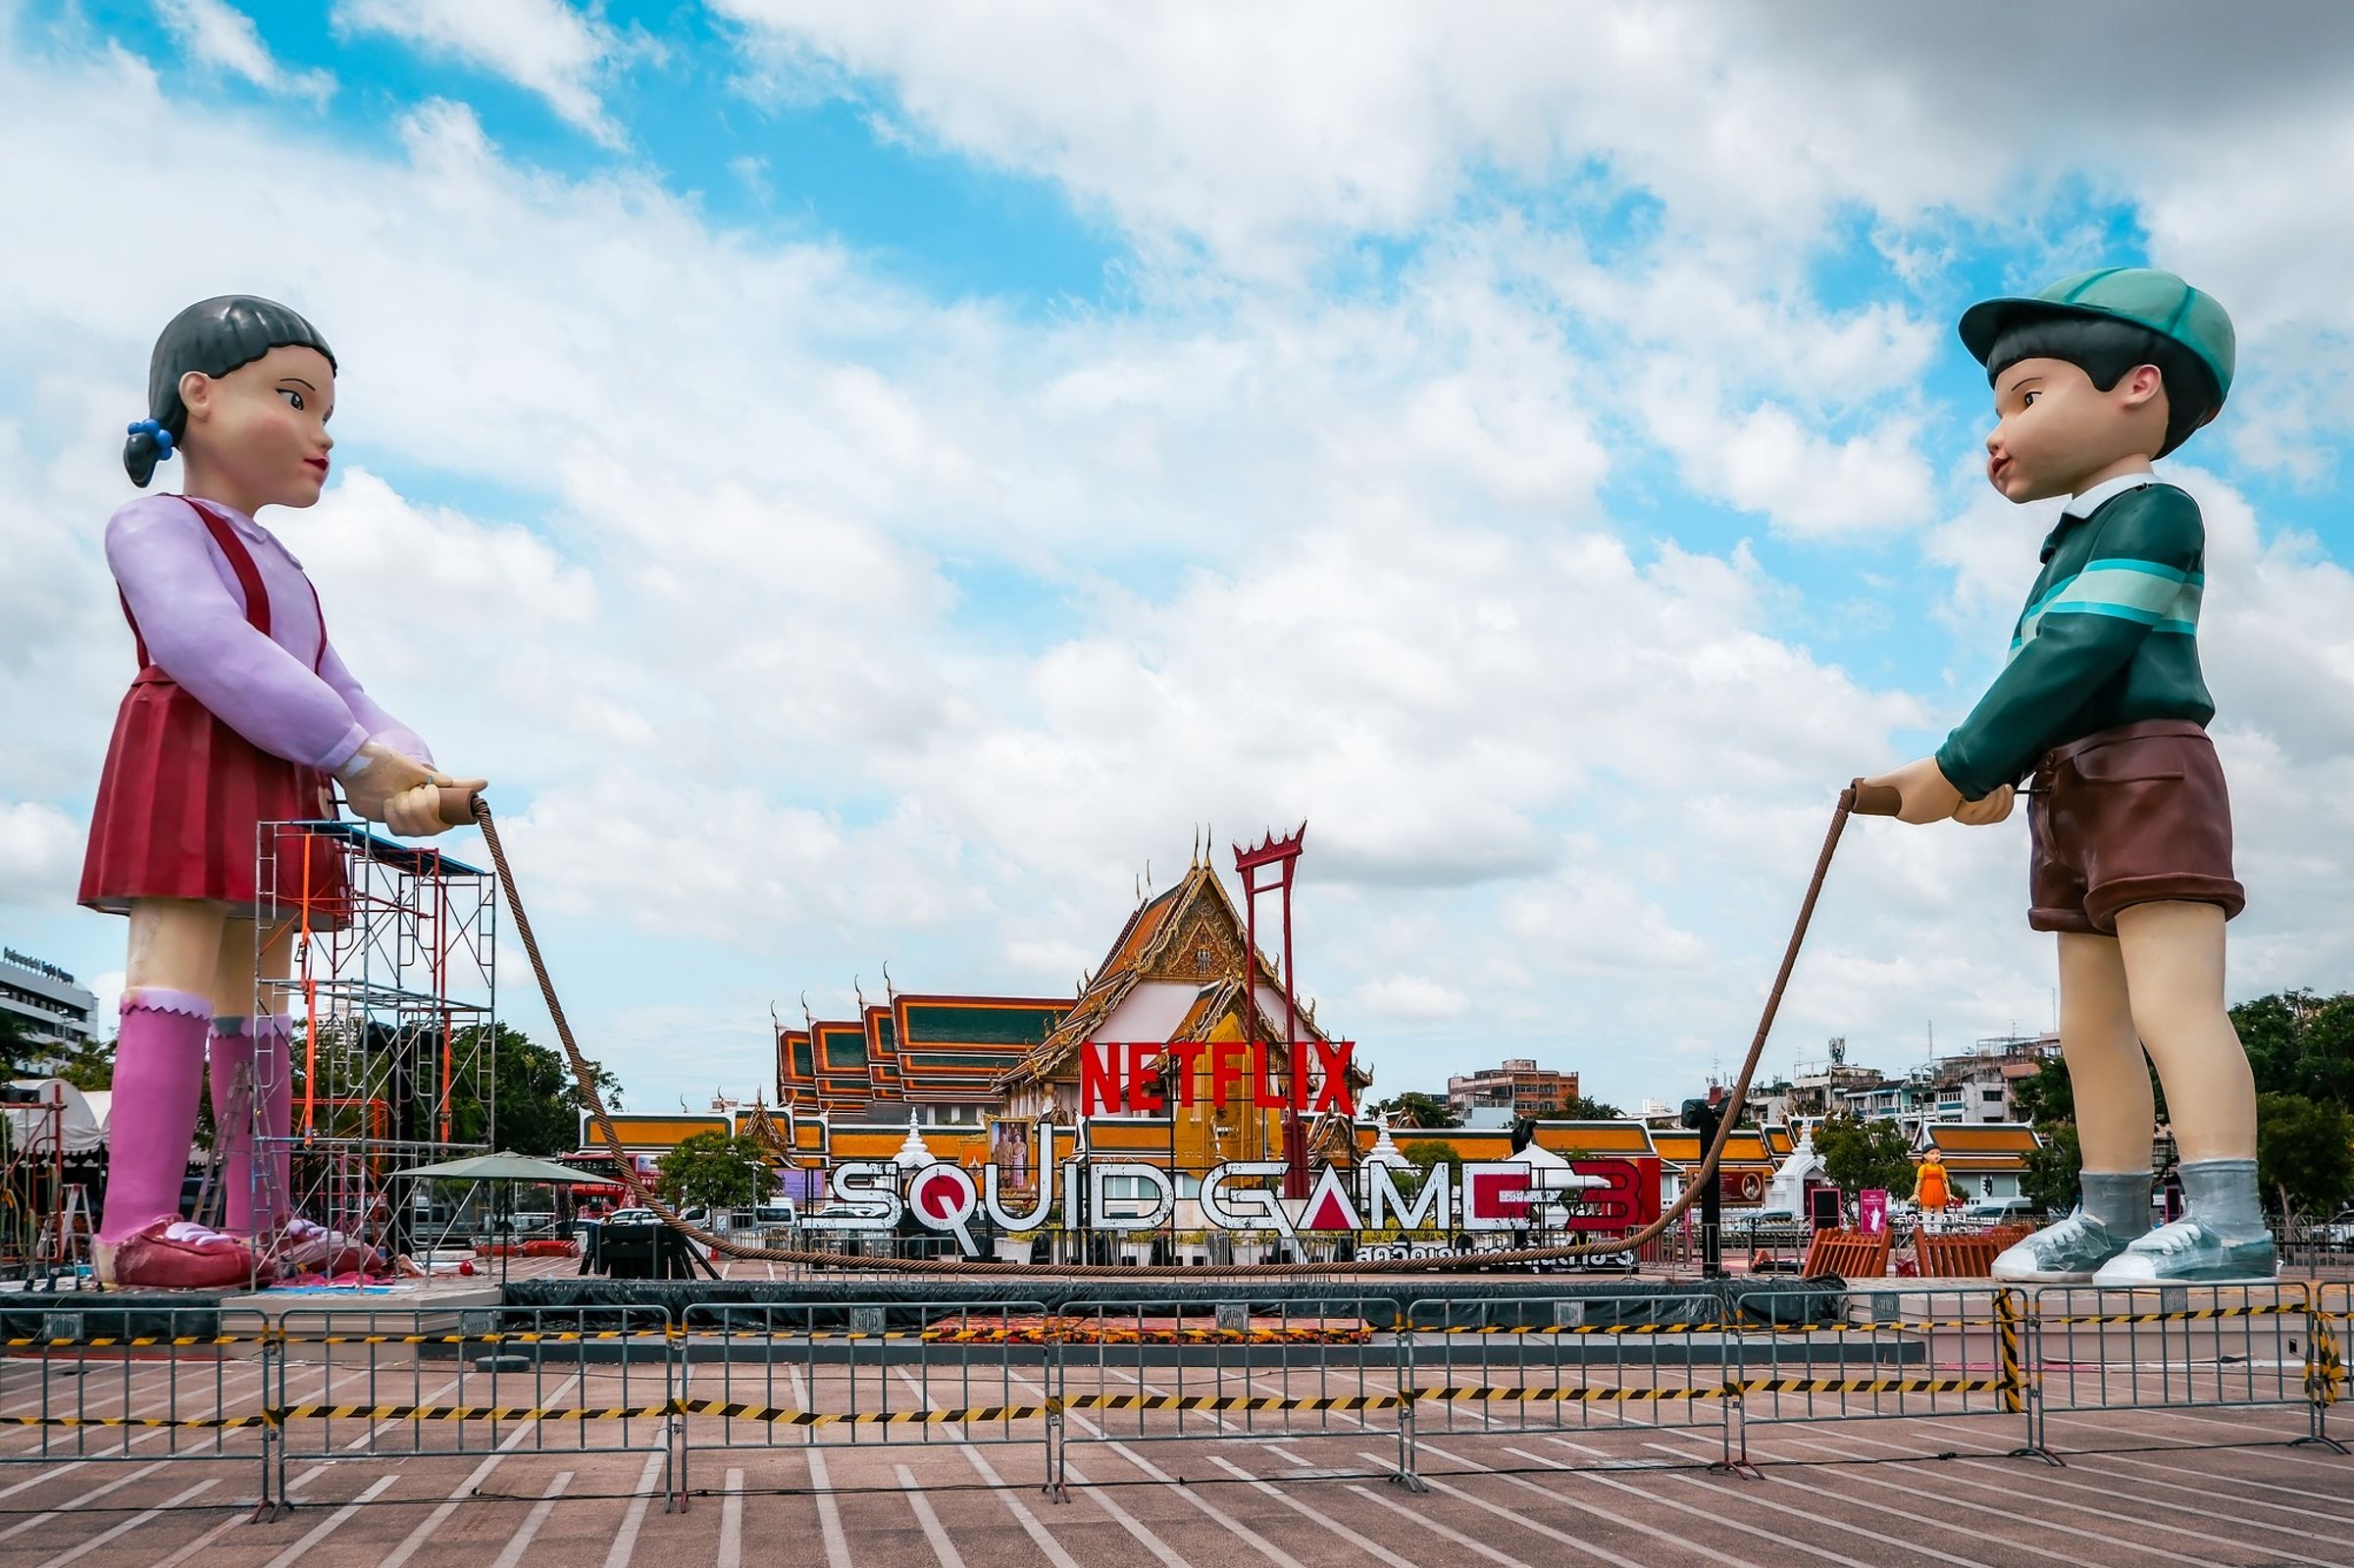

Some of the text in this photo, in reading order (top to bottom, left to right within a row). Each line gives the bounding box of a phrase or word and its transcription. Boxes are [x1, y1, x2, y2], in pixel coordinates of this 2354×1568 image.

[1081, 1040, 1357, 1117] NETFLIX
[800, 1122, 1176, 1257] SQUID
[1200, 1160, 1563, 1264] GAME
